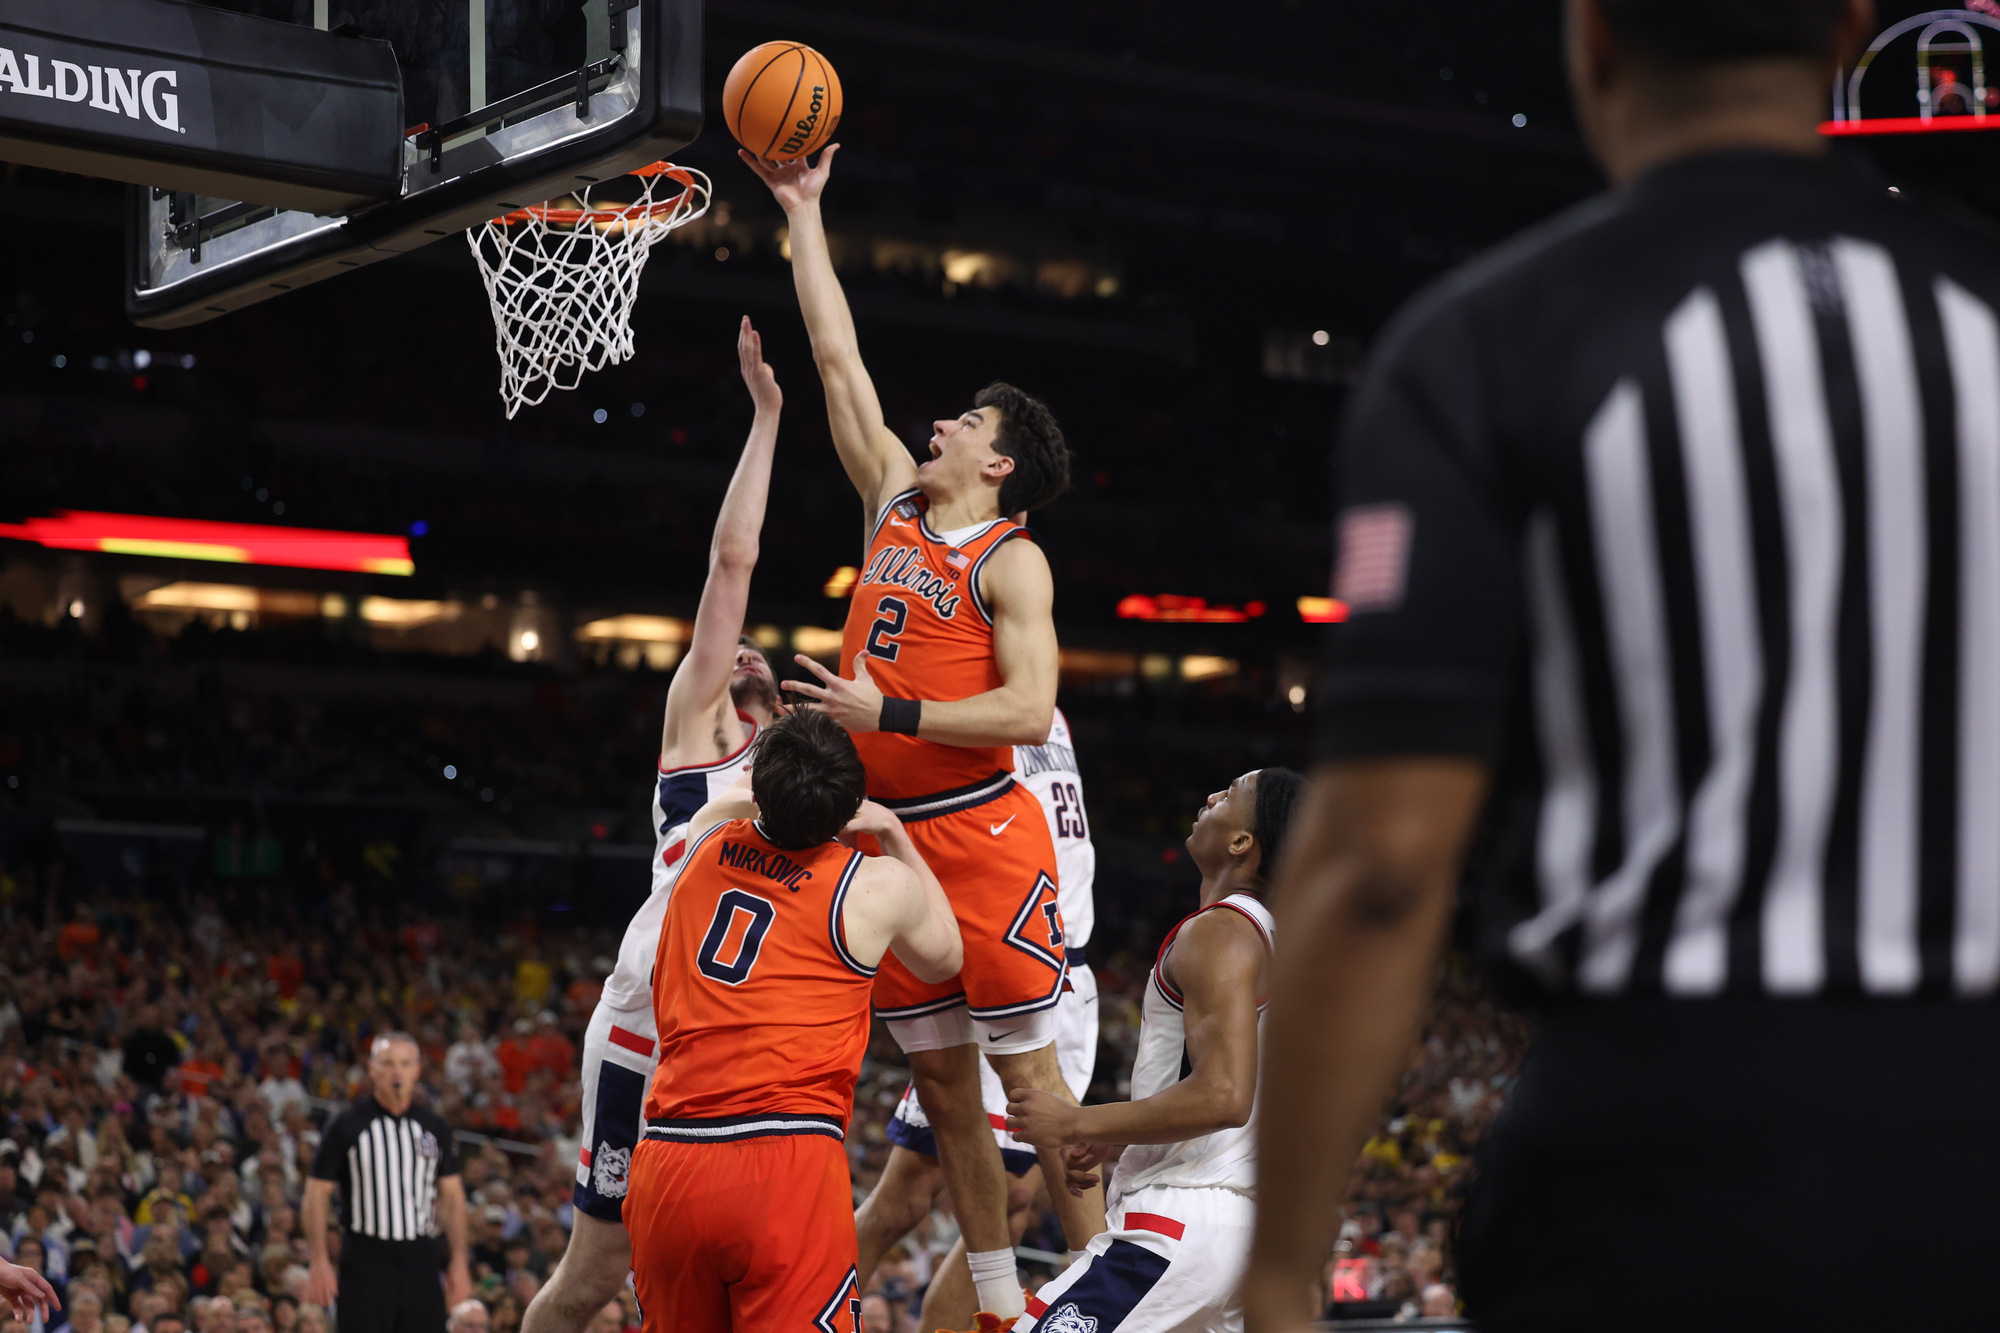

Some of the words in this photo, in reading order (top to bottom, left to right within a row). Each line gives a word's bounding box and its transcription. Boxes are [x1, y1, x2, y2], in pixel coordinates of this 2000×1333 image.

[0, 47, 179, 132] ALDING
[779, 85, 824, 154] Wilson
[862, 545, 961, 620] Illinois
[866, 595, 908, 663] 2
[1051, 782, 1086, 838] 23
[718, 841, 813, 893] MIRKOVIC
[696, 888, 777, 987] 0
[1041, 899, 1063, 948] I
